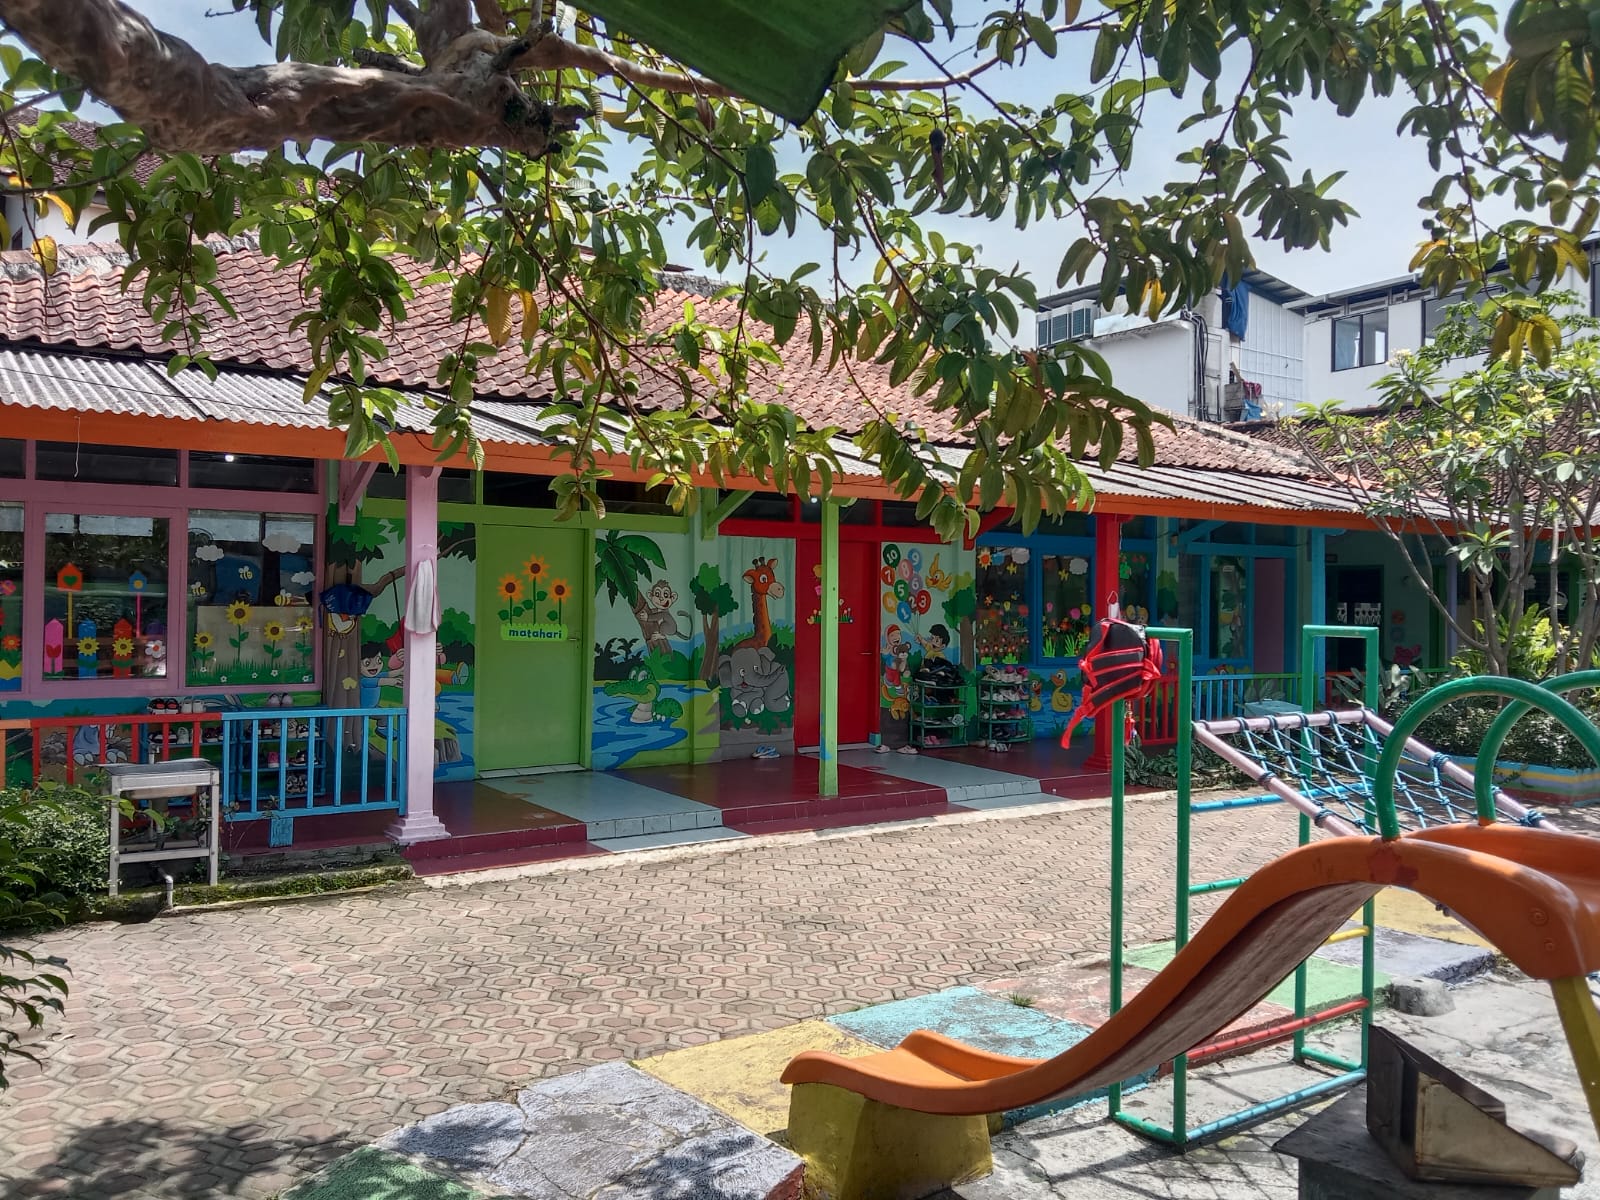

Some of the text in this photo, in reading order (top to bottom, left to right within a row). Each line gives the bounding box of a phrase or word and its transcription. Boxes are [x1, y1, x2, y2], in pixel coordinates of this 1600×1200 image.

[887, 550, 898, 564] 10
[912, 552, 919, 565] 9
[885, 570, 891, 583] 7
[902, 564, 909, 578] 8
[898, 584, 904, 597] 5
[912, 579, 919, 590] 6
[909, 596, 916, 608] 2
[919, 596, 926, 608] 3
[901, 608, 908, 620] 1
[509, 628, 561, 638] matahari
